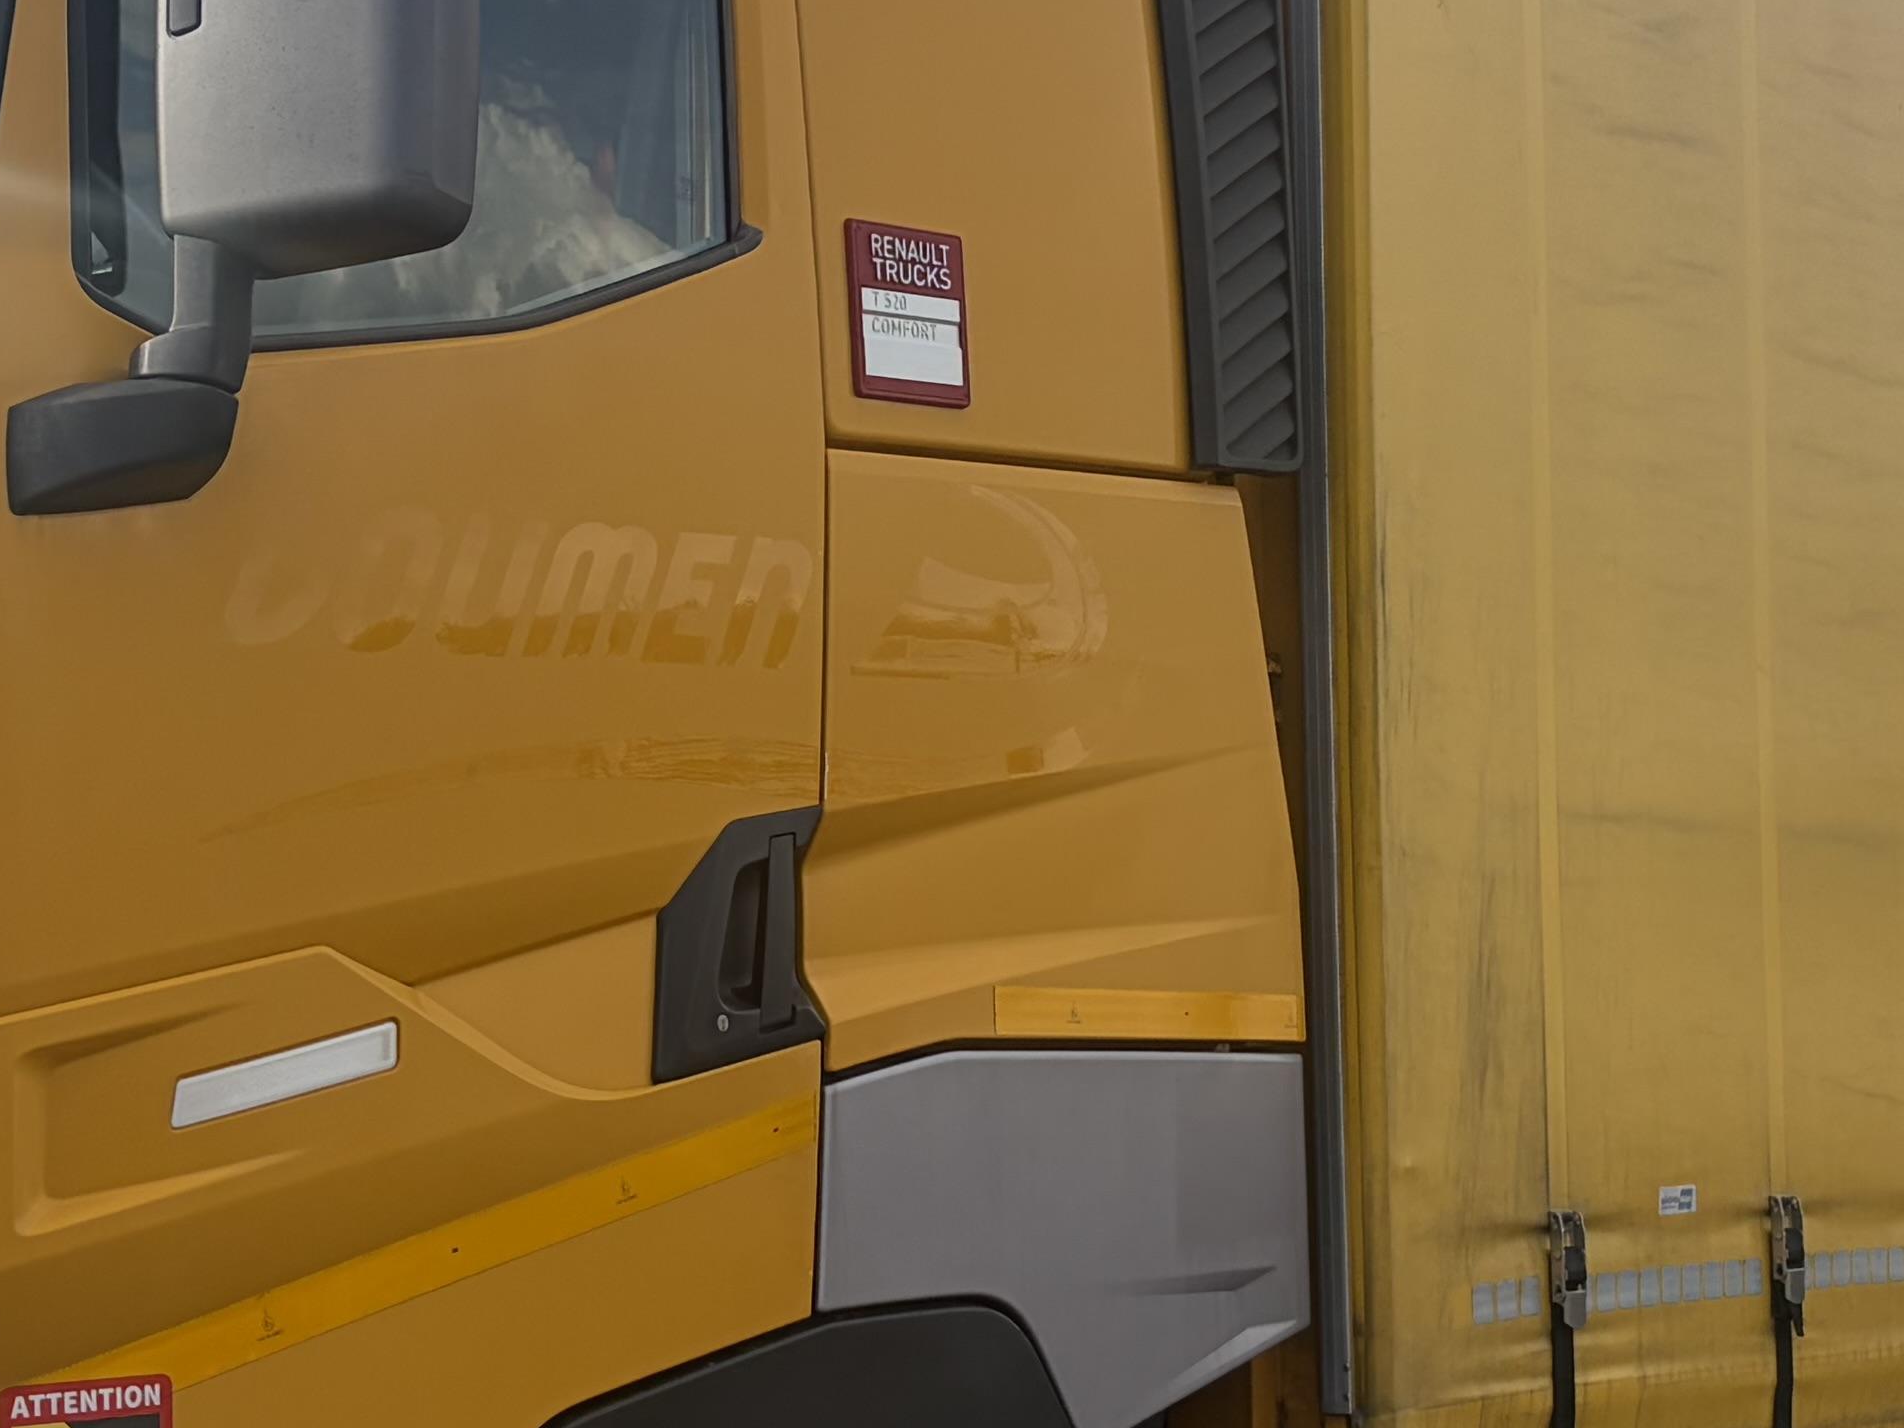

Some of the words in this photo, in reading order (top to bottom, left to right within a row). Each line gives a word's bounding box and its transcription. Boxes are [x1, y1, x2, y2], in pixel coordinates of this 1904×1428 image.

[870, 233, 950, 266] RENAULT
[872, 257, 952, 290] TRUCKS
[871, 291, 880, 307] T
[884, 293, 908, 311] 520
[871, 316, 937, 342] COMFORT
[10, 1383, 162, 1419] ATTENTION
